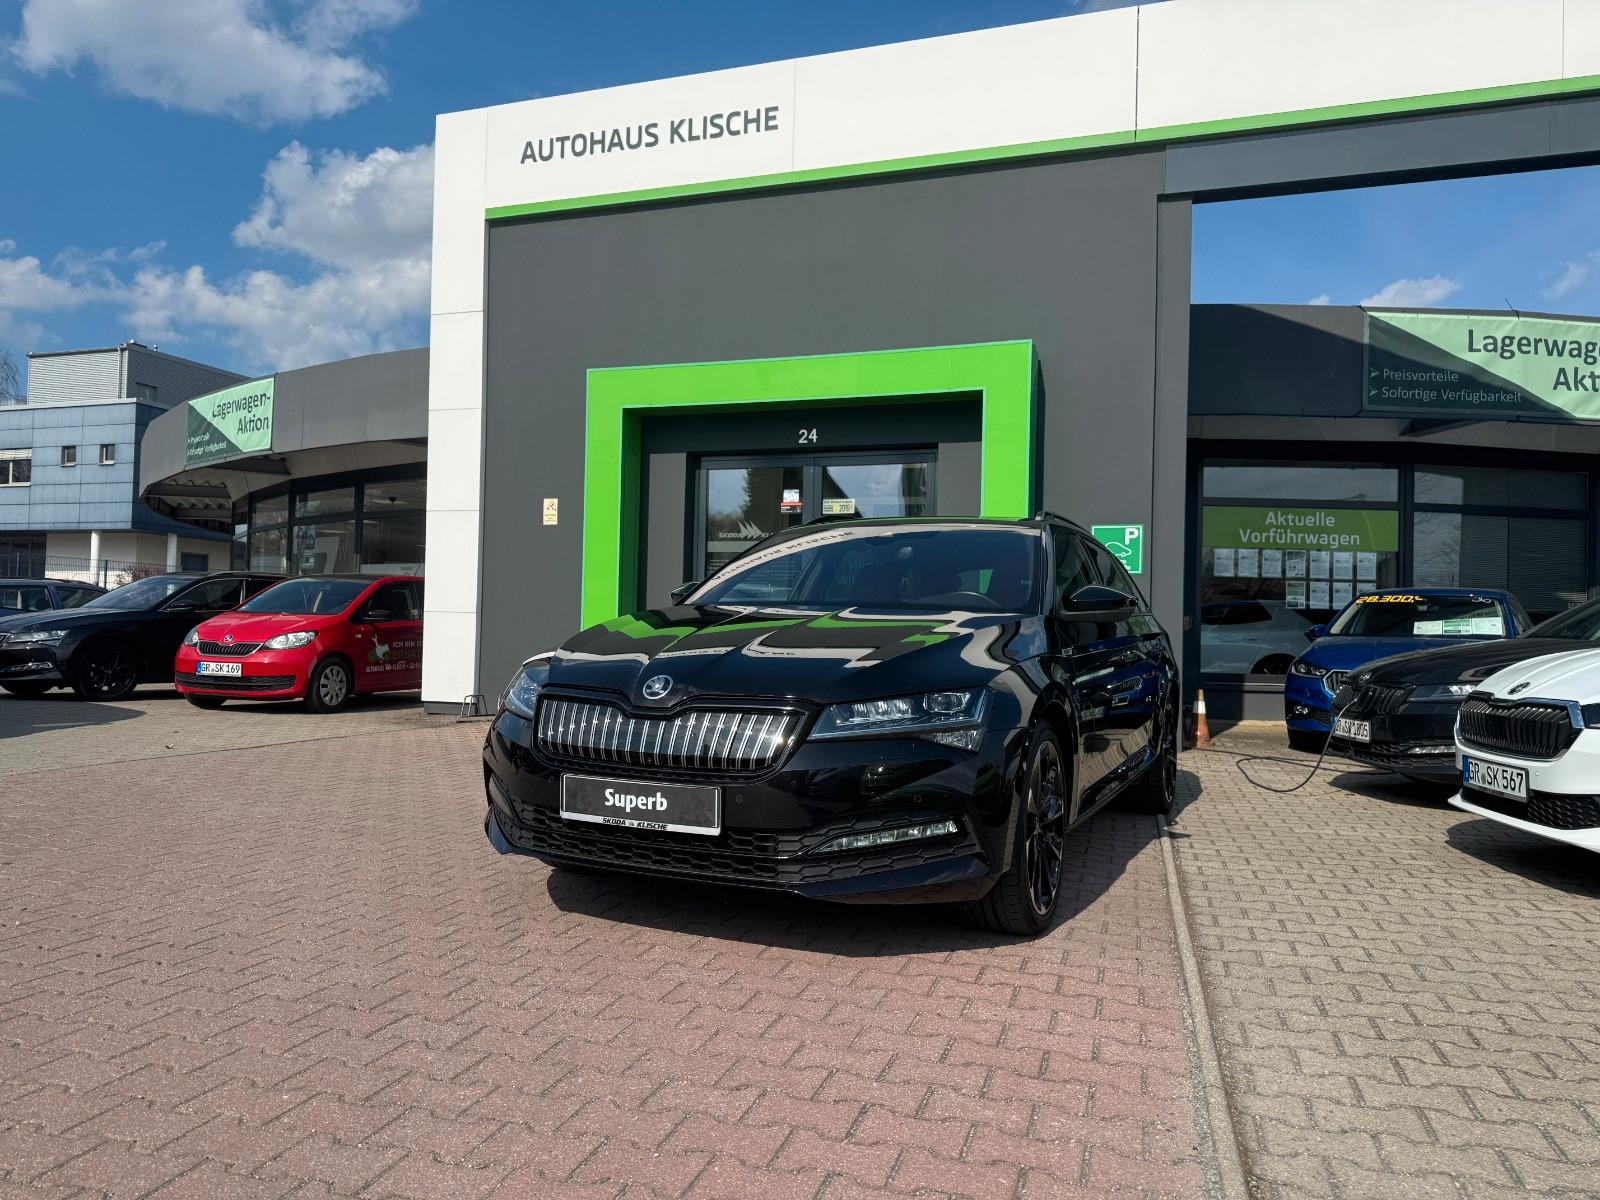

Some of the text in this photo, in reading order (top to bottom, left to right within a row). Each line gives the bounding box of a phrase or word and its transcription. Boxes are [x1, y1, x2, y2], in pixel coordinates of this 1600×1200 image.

[520, 106, 779, 164] AUTOHAUS KLISCHE
[1467, 329, 1600, 366] Lagerwag
[1383, 368, 1459, 382] Preisvorteile
[1382, 386, 1522, 404] Sofortige Verfügbarkeit
[212, 392, 271, 420] Lagerwagen-
[236, 414, 269, 436] Aktion
[798, 428, 818, 444] 24
[1265, 511, 1335, 527] Aktuelle
[1125, 528, 1139, 545] P
[1239, 528, 1360, 548] Vorführwagen
[201, 663, 241, 674] GR SK 169
[1469, 761, 1480, 783] GR
[1486, 765, 1500, 788] SK
[1501, 768, 1524, 793] 567
[604, 788, 668, 812] Superb
[602, 817, 668, 831] SKODA KLISCHE
